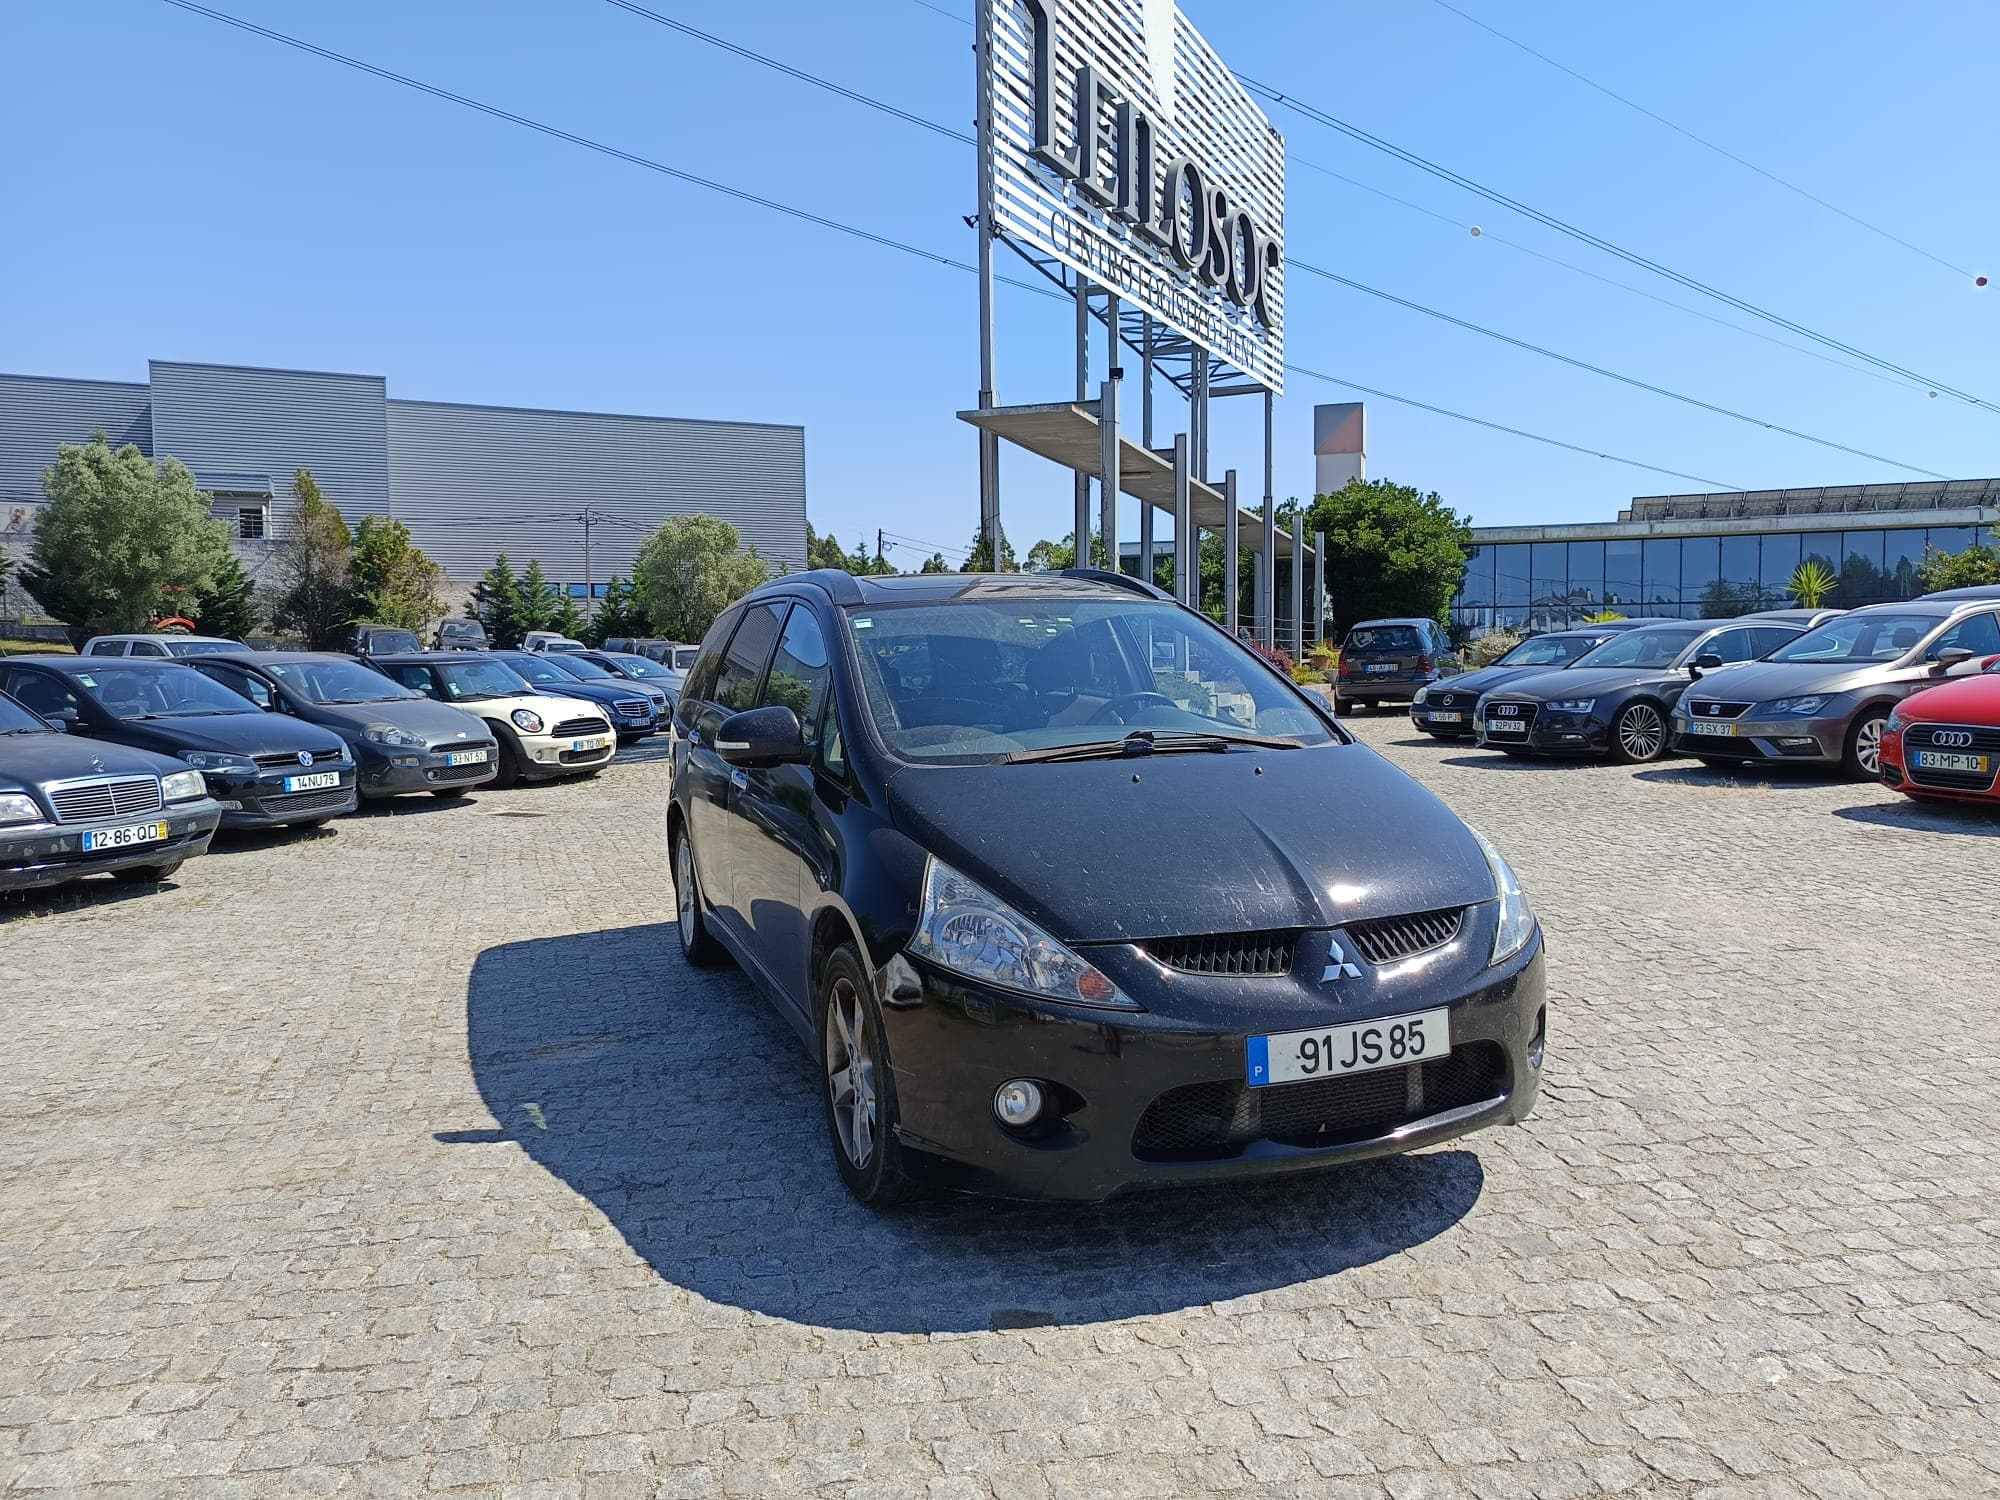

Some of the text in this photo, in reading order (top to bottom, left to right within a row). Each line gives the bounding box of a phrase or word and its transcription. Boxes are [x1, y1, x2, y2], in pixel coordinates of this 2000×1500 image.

[1051, 211, 1132, 293] CENTRO
[1254, 1019, 1425, 1077] P 91JS85
